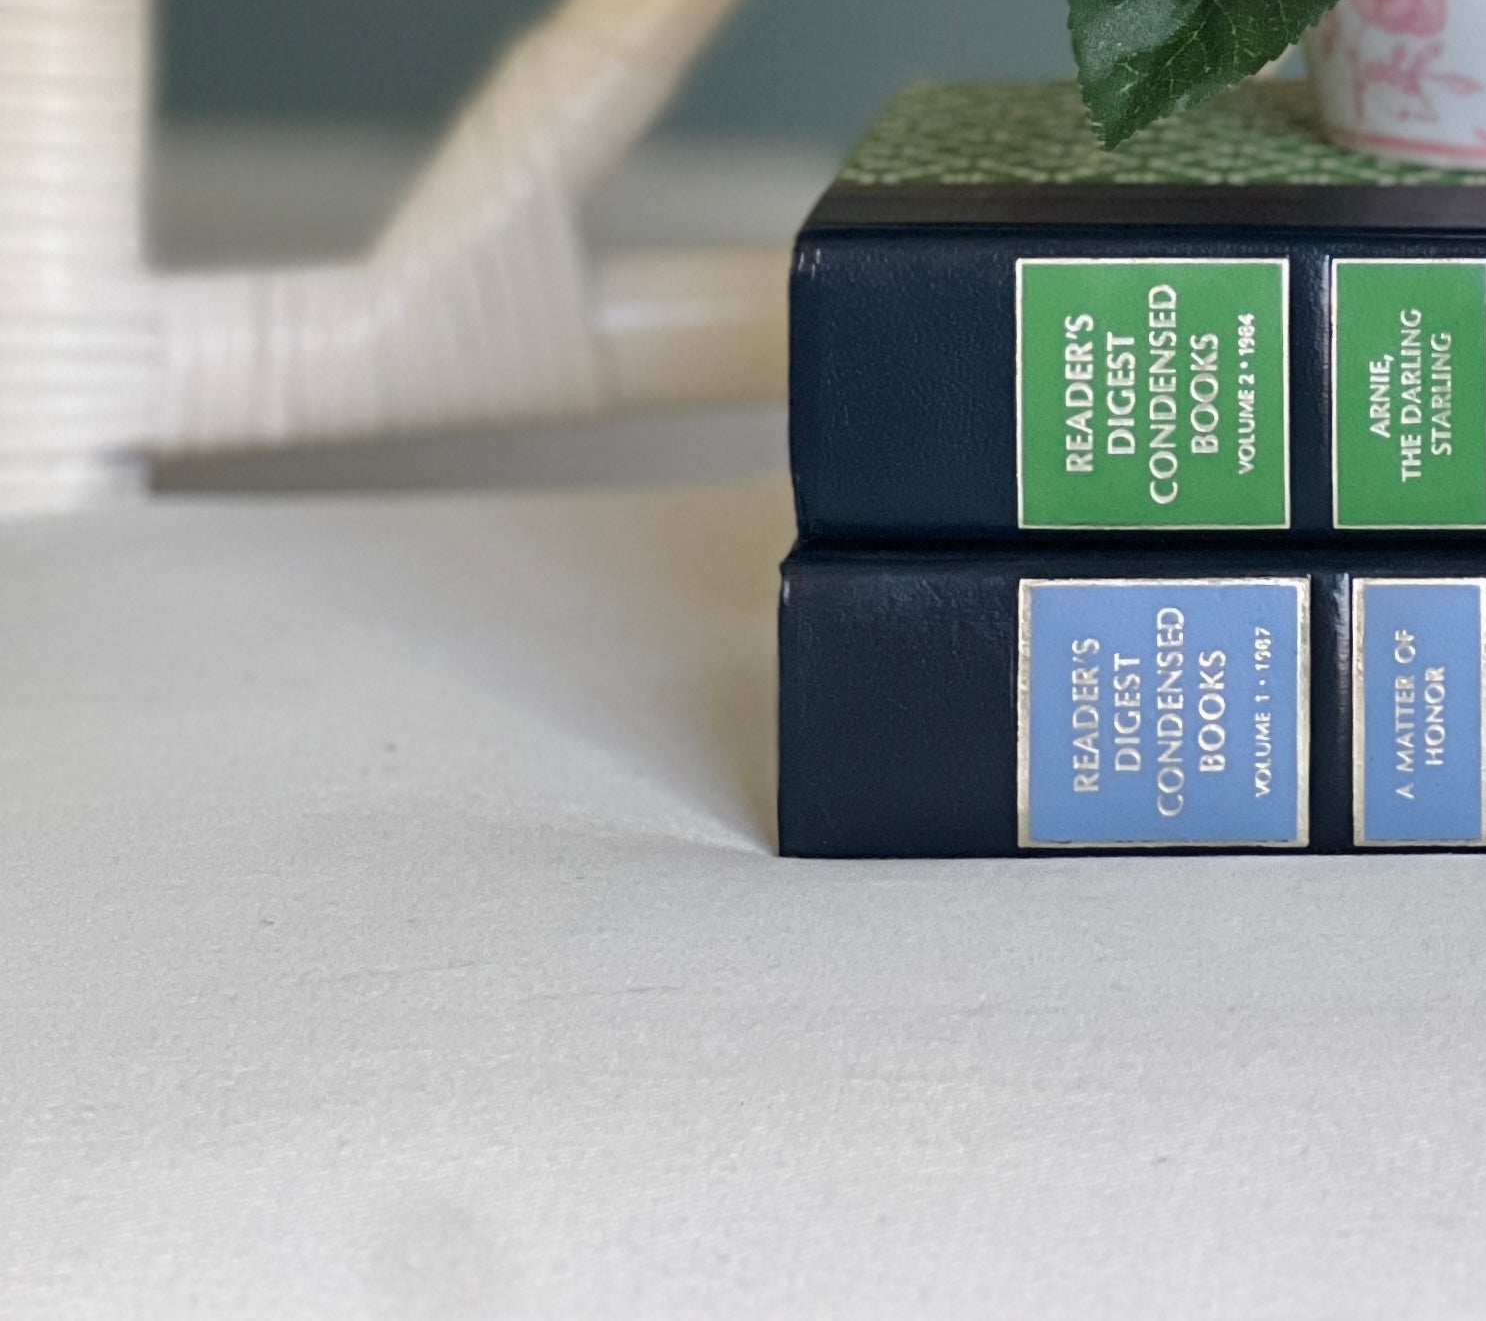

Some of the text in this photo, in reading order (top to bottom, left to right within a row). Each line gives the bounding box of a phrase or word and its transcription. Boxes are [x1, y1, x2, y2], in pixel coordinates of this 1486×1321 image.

[1064, 313, 1094, 474] READER'S
[1106, 331, 1136, 455] DIGEST
[1148, 283, 1179, 506] CONDENSED
[1189, 332, 1220, 455] BOOKS
[1237, 313, 1257, 476] VOLUME 2 1984
[1368, 353, 1395, 439] ARNIE,
[1401, 308, 1422, 482] THE DARLING
[1430, 331, 1452, 457] STARLING
[1071, 637, 1100, 793] READER'S
[1113, 652, 1142, 772] DIGEST
[1156, 606, 1185, 818] CONDENSED
[1197, 649, 1227, 772] BOOKS
[1254, 711, 1271, 798] VOLUME
[1255, 694, 1271, 703] 1
[1394, 628, 1416, 799] A MATTER OF
[1424, 665, 1446, 765] HONOR
